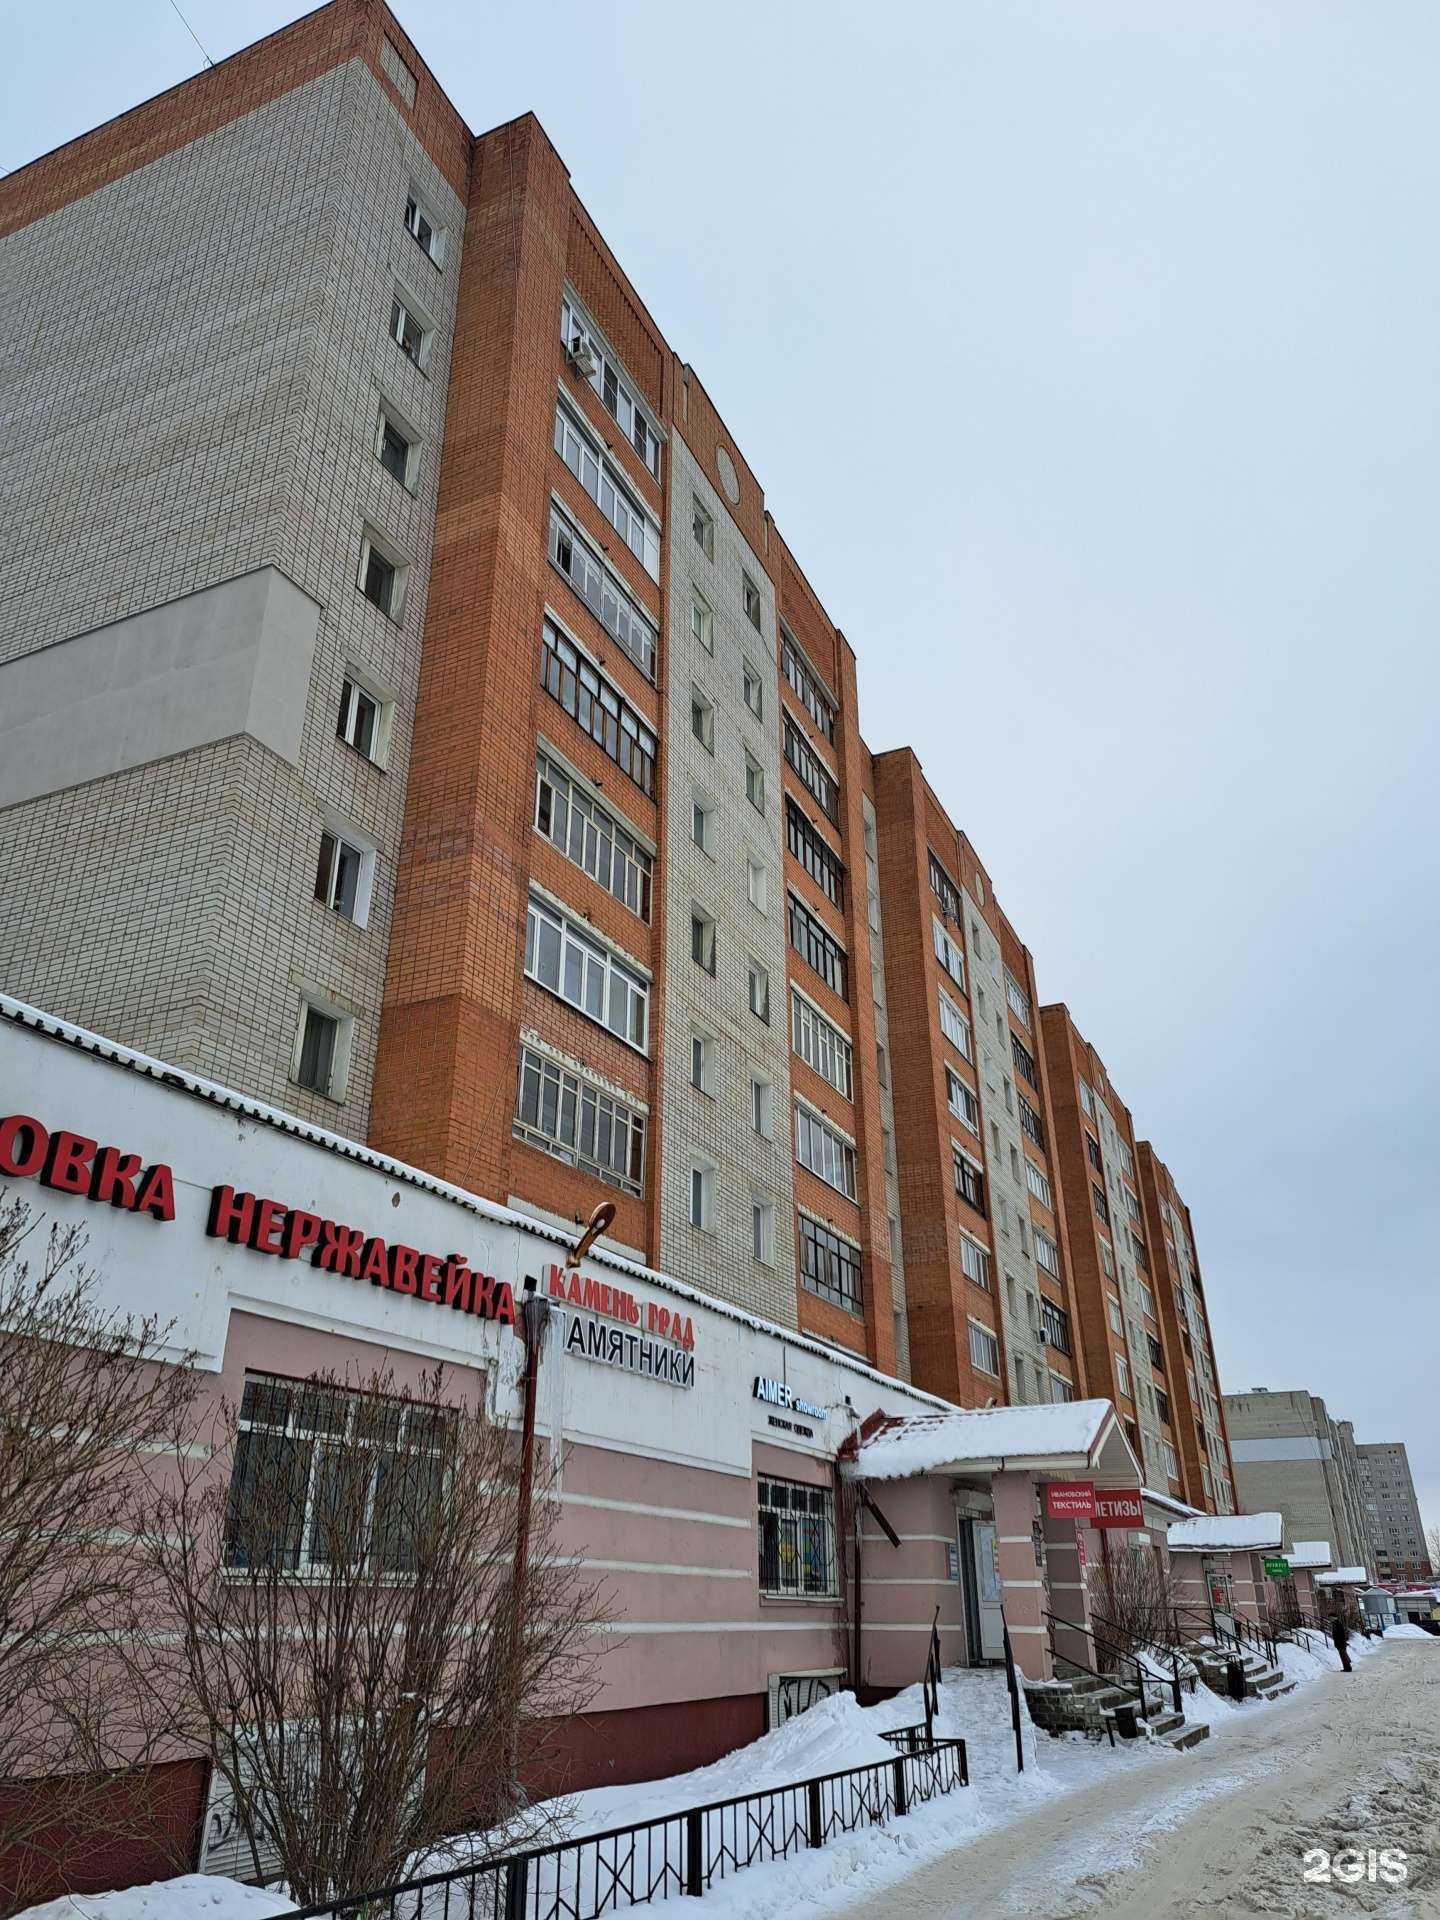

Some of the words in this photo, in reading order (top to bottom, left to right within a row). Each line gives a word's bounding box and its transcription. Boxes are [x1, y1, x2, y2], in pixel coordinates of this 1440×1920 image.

[206, 1185, 516, 1325] НЕРЖАВЕЙКА
[549, 1264, 640, 1325] КАМЕНЬ
[647, 1302, 695, 1352] ГРАД
[562, 1316, 695, 1387] АМЯТНИКИ
[754, 1376, 793, 1408] AIMER
[1050, 1489, 1092, 1498] ИВАНОВСКИЙ
[1052, 1500, 1092, 1510] ТЕКСТИЛЬ
